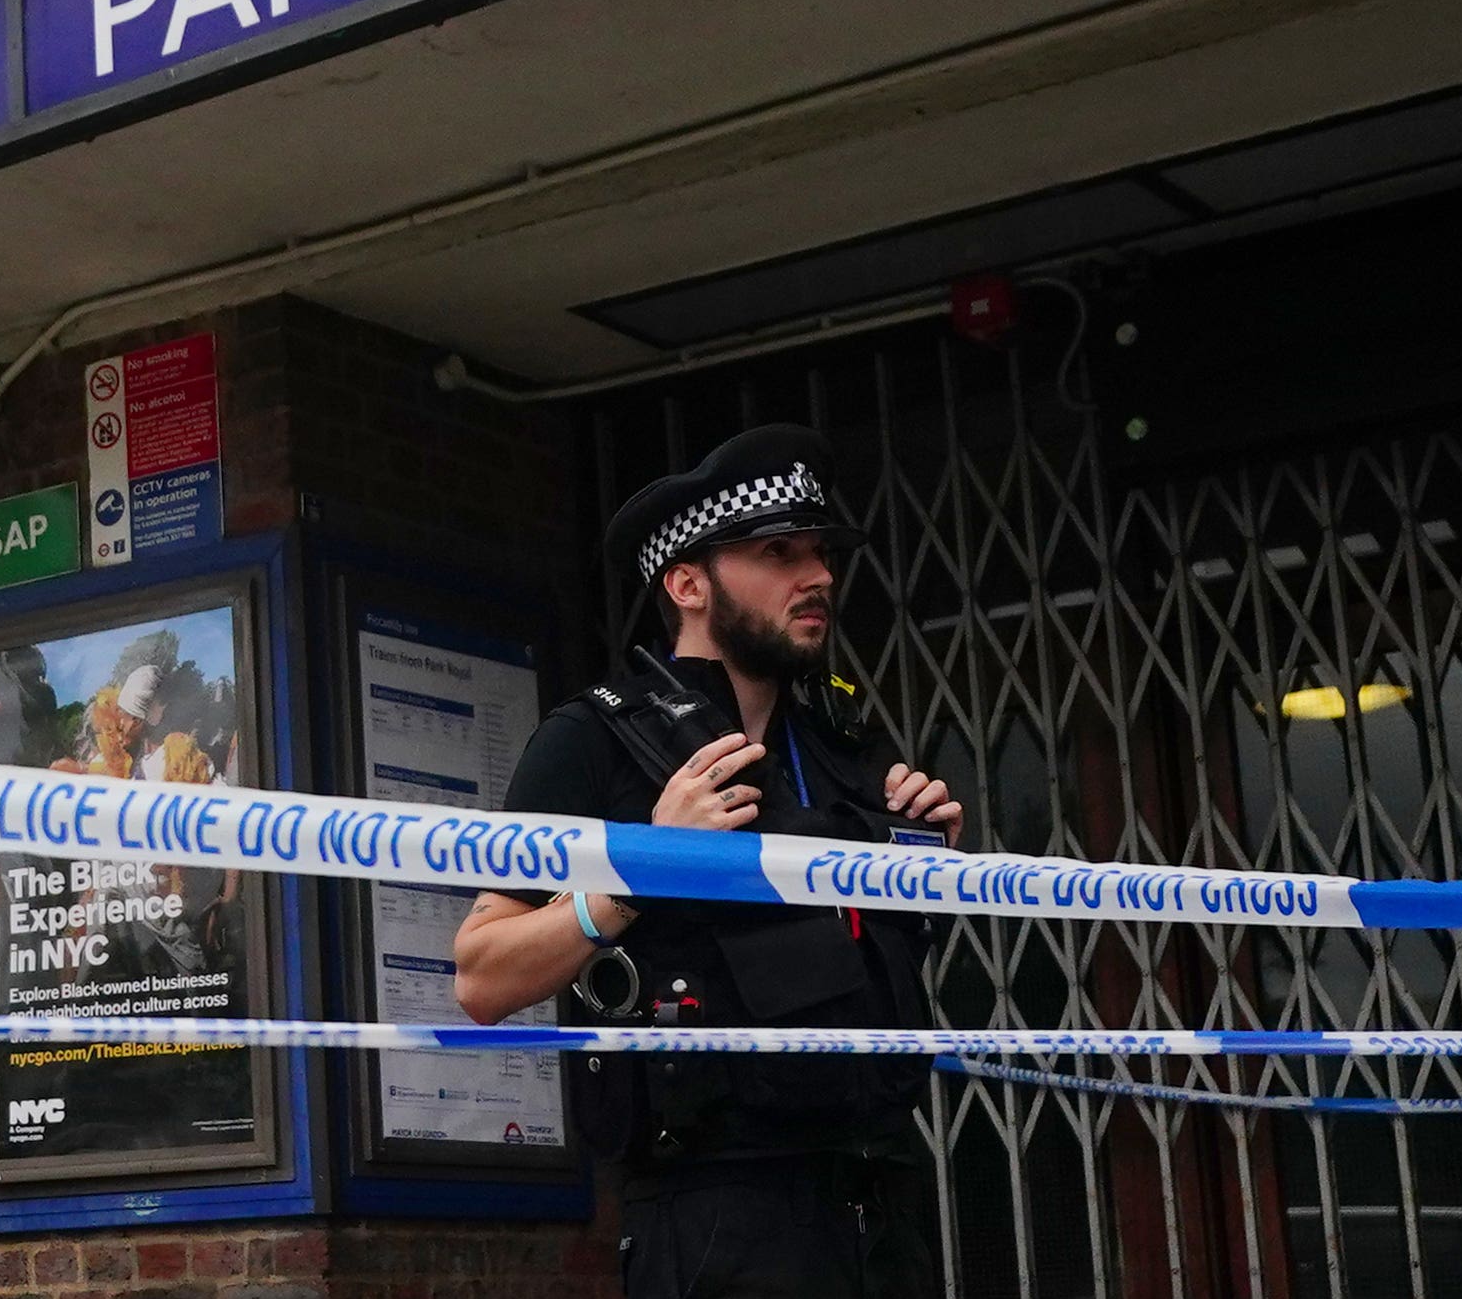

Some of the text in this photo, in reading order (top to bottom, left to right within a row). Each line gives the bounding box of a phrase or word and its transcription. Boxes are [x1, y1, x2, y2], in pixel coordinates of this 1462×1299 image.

[133, 470, 212, 496] CCTV cameras
[146, 488, 198, 508] operation
[593, 686, 622, 707] 3143
[118, 787, 229, 855] LINE
[238, 801, 305, 860] DO
[318, 809, 423, 869] NOT
[424, 817, 582, 881] CROSS
[8, 859, 155, 899] The Black
[806, 850, 962, 898] POLICE
[957, 859, 1046, 905] LINE
[9, 893, 183, 935] Experience
[9, 933, 109, 973] in NYC
[9, 972, 229, 1004] Explore Black-owned businesses
[36, 1002, 131, 1021] neighborhood
[132, 997, 181, 1014] culture
[183, 993, 229, 1009] across
[9, 1098, 65, 1125] NYC
[16, 1124, 45, 1135] Company
